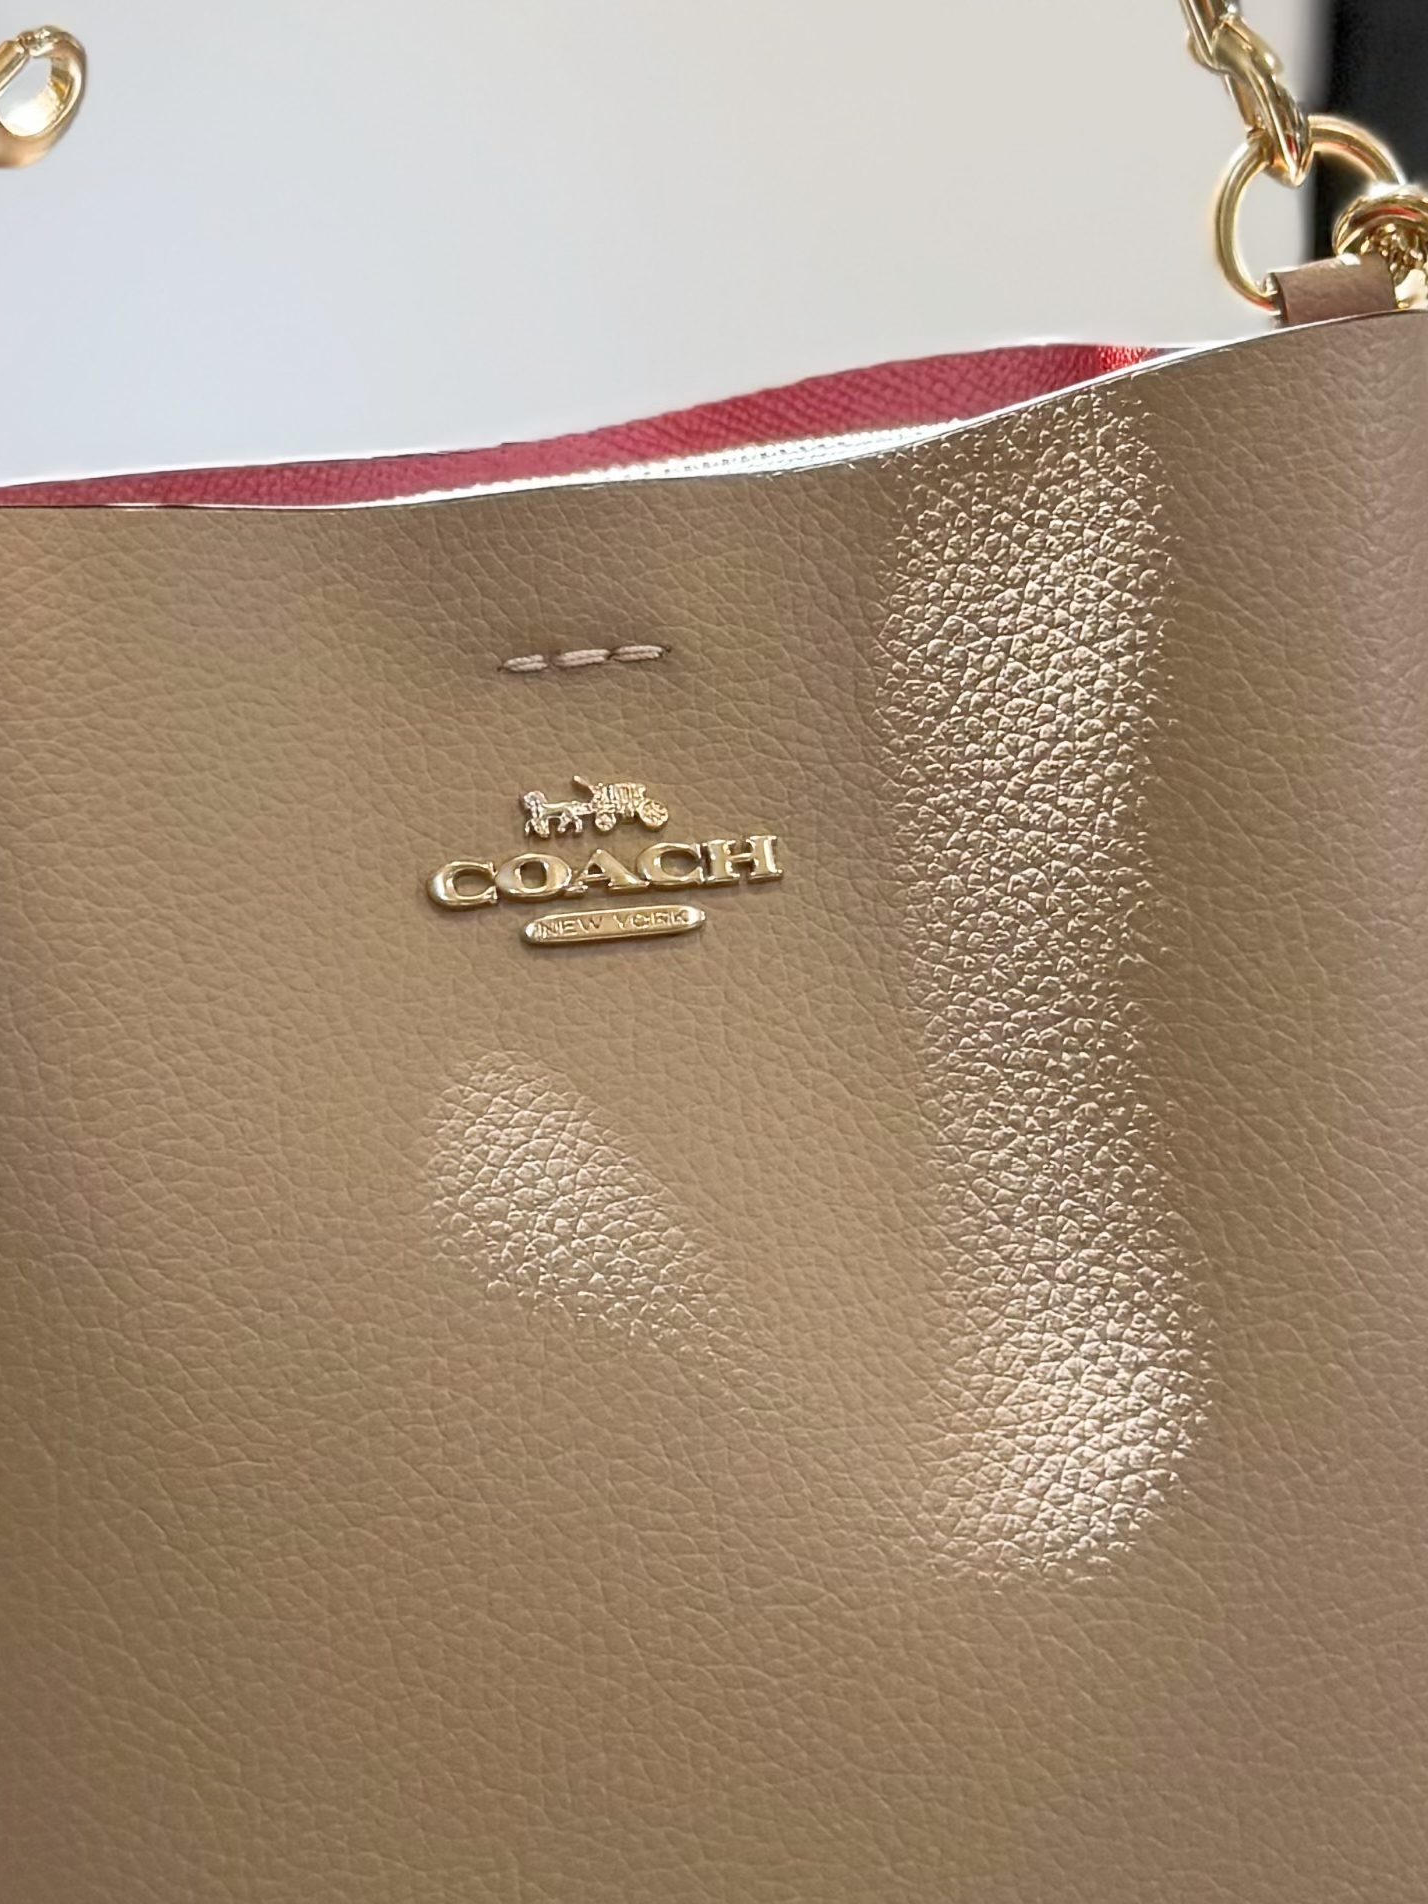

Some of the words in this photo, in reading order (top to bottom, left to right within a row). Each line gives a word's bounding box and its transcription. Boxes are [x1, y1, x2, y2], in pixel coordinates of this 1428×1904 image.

[429, 834, 783, 908] COACH
[537, 910, 603, 939] NEW
[613, 904, 690, 929] YORK
